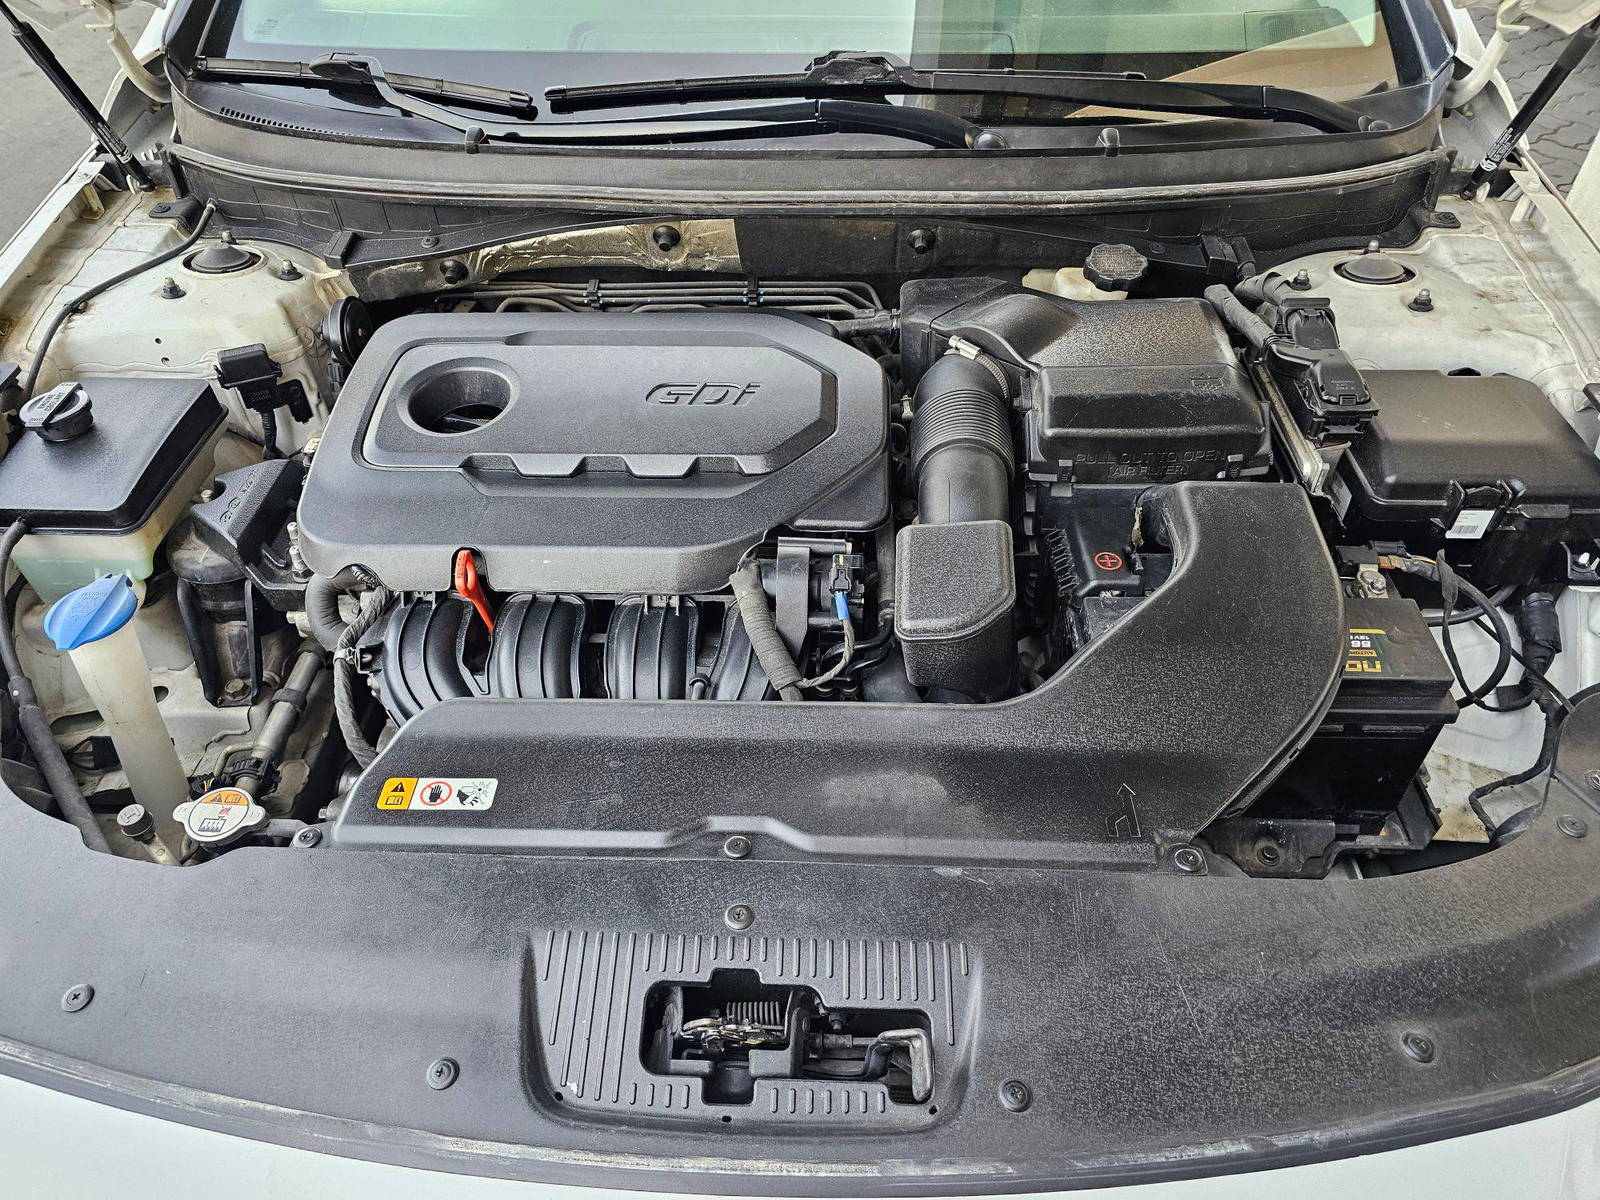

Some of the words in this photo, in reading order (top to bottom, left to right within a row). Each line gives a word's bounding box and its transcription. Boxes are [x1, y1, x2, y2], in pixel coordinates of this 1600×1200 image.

[1074, 453, 1118, 465] PULL
[1118, 452, 1156, 465] OUT
[1158, 451, 1178, 464] TO
[1182, 449, 1228, 462] OPEN
